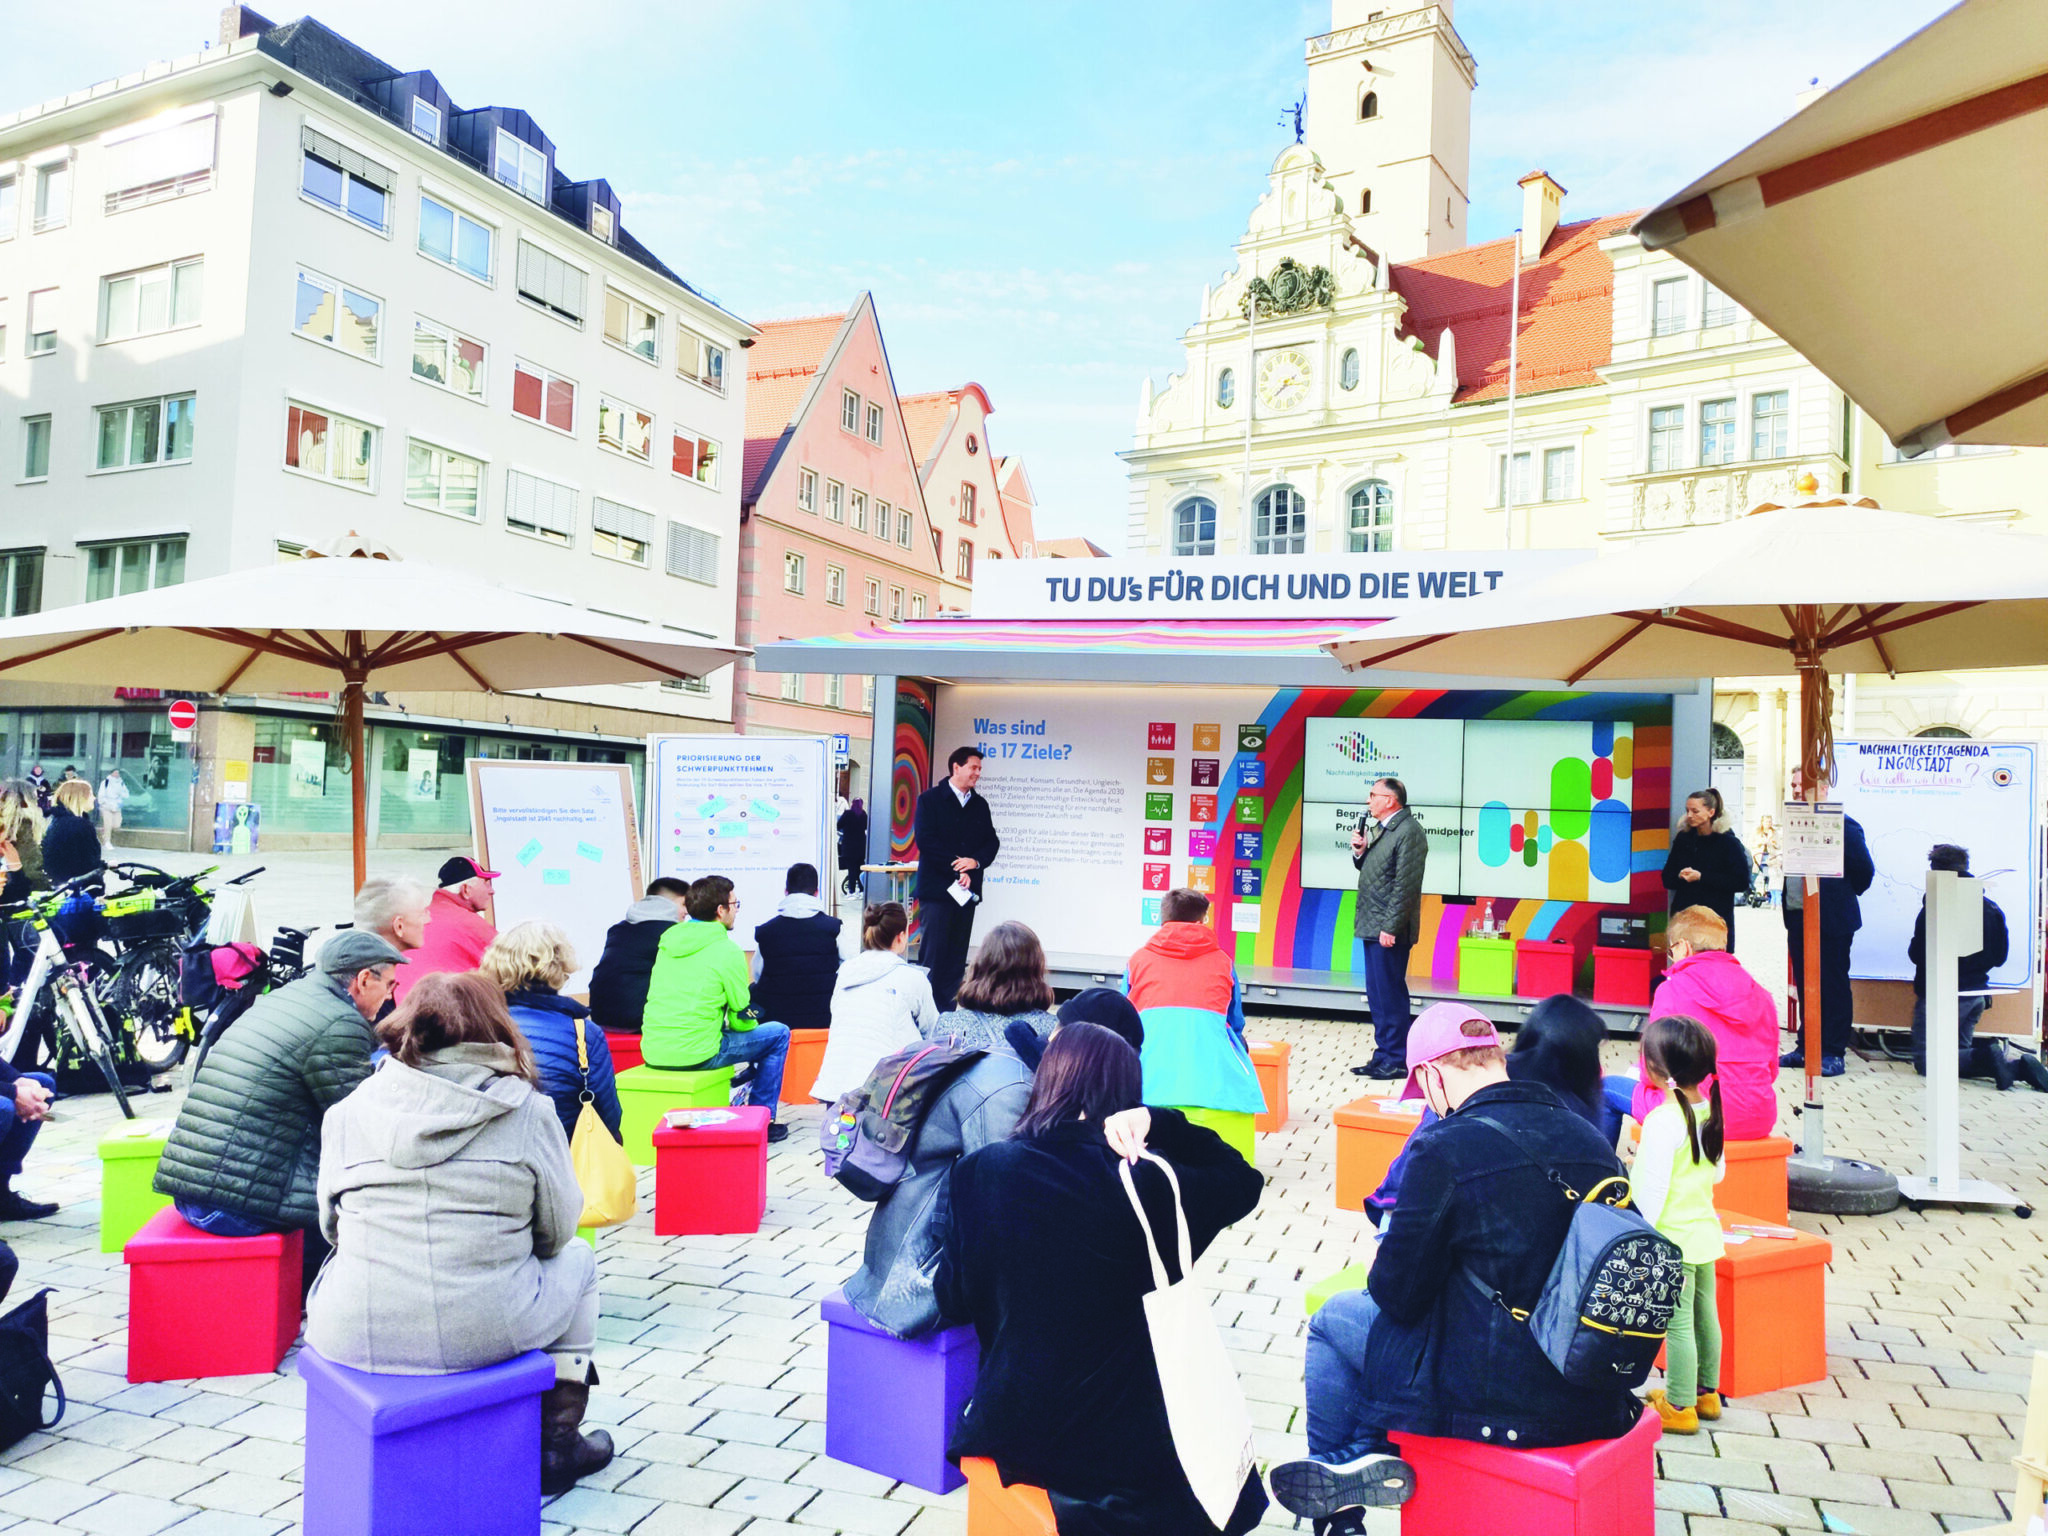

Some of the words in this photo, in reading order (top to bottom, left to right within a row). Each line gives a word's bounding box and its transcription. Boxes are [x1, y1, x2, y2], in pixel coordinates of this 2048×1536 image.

[1046, 577, 1080, 602] TU
[1088, 576, 1142, 602] DU's
[1148, 570, 1203, 601] FÜR
[1212, 574, 1279, 600] DICH
[1287, 573, 1351, 600] UND
[1360, 572, 1408, 599] DIE
[1417, 571, 1504, 598] WELT
[974, 718, 1006, 735] Was
[1011, 719, 1046, 735] sind
[1001, 743, 1018, 759] 17
[1021, 743, 1072, 760] Ziele?
[1859, 744, 1990, 758] NACHHALTIGKEITSAGENDA
[1877, 756, 1954, 773] INGOLSTADT
